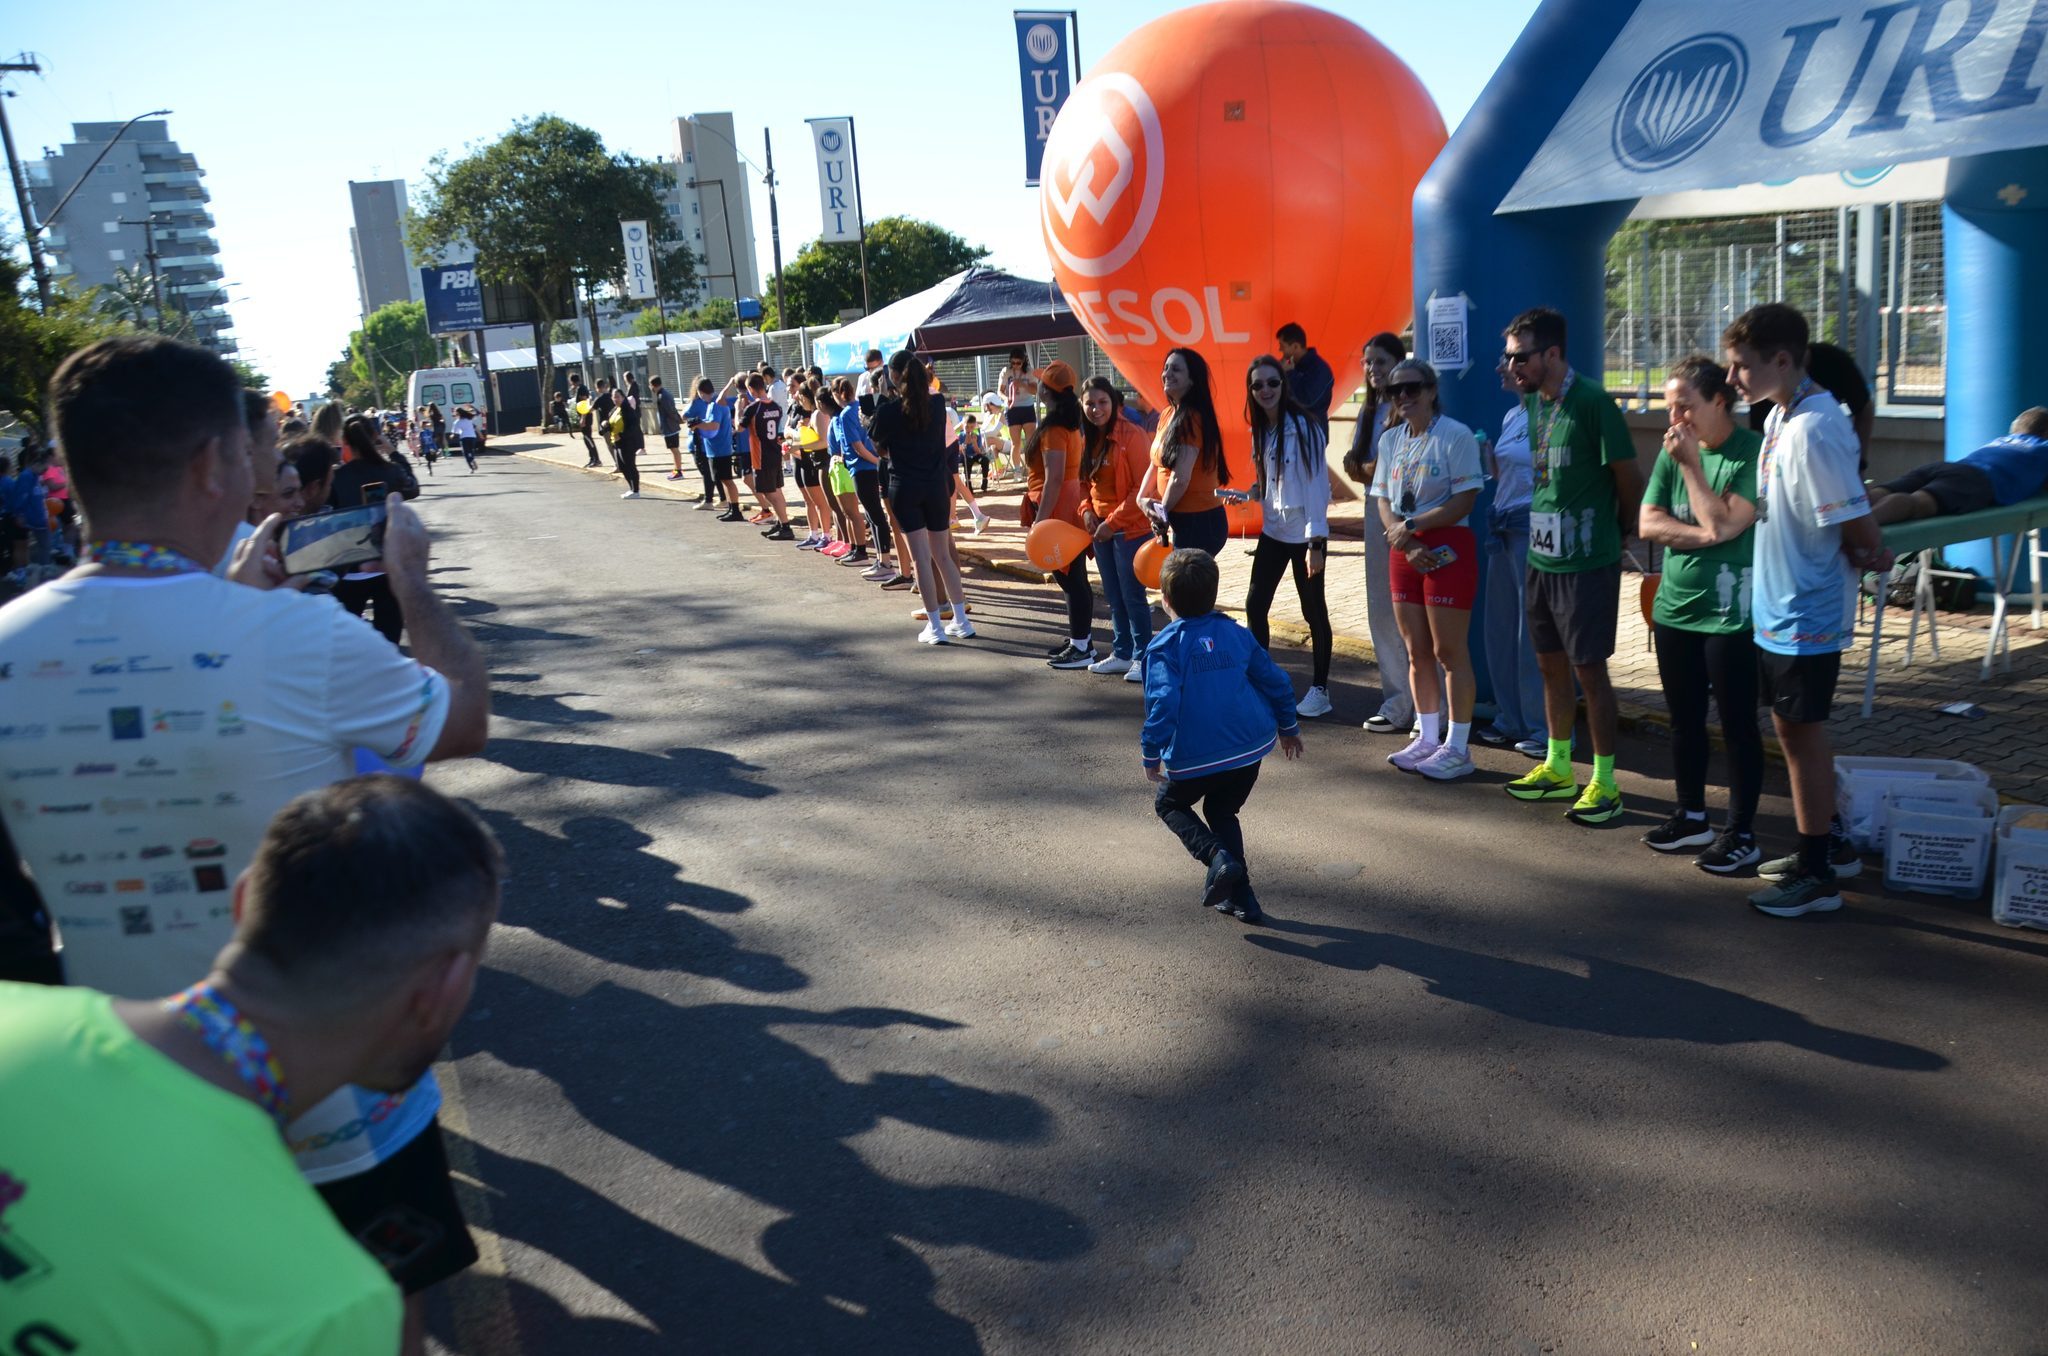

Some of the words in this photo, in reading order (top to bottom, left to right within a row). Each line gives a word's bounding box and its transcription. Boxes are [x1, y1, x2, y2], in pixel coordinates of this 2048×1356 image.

[1031, 69, 1059, 147] UR
[824, 160, 848, 235] URI
[630, 246, 646, 294] URI
[767, 420, 776, 440] 9
